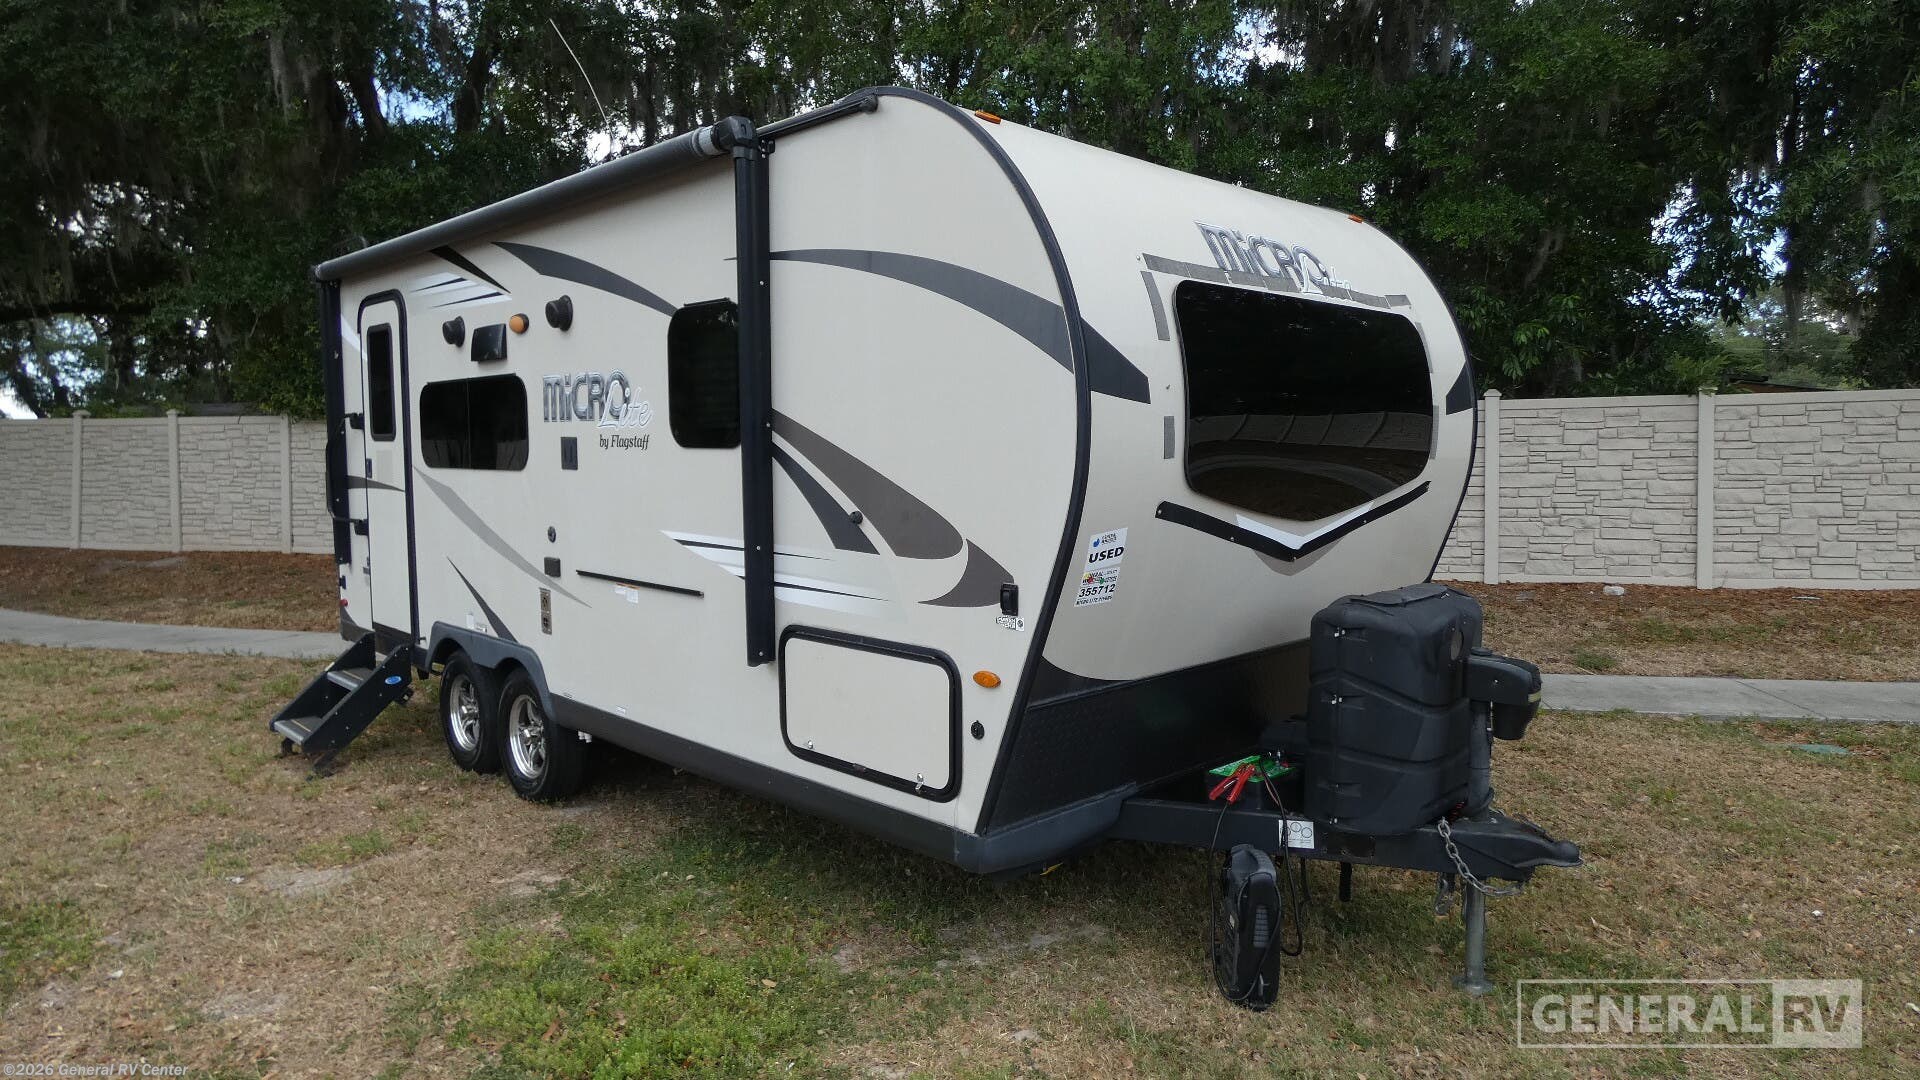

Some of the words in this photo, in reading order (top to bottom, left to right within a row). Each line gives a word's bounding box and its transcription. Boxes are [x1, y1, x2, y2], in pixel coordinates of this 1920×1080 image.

[597, 379, 652, 430] Lite
[599, 434, 609, 450] by
[611, 434, 650, 450] Flagstaff
[1089, 547, 1124, 563] USED
[1079, 584, 1115, 598] 355712
